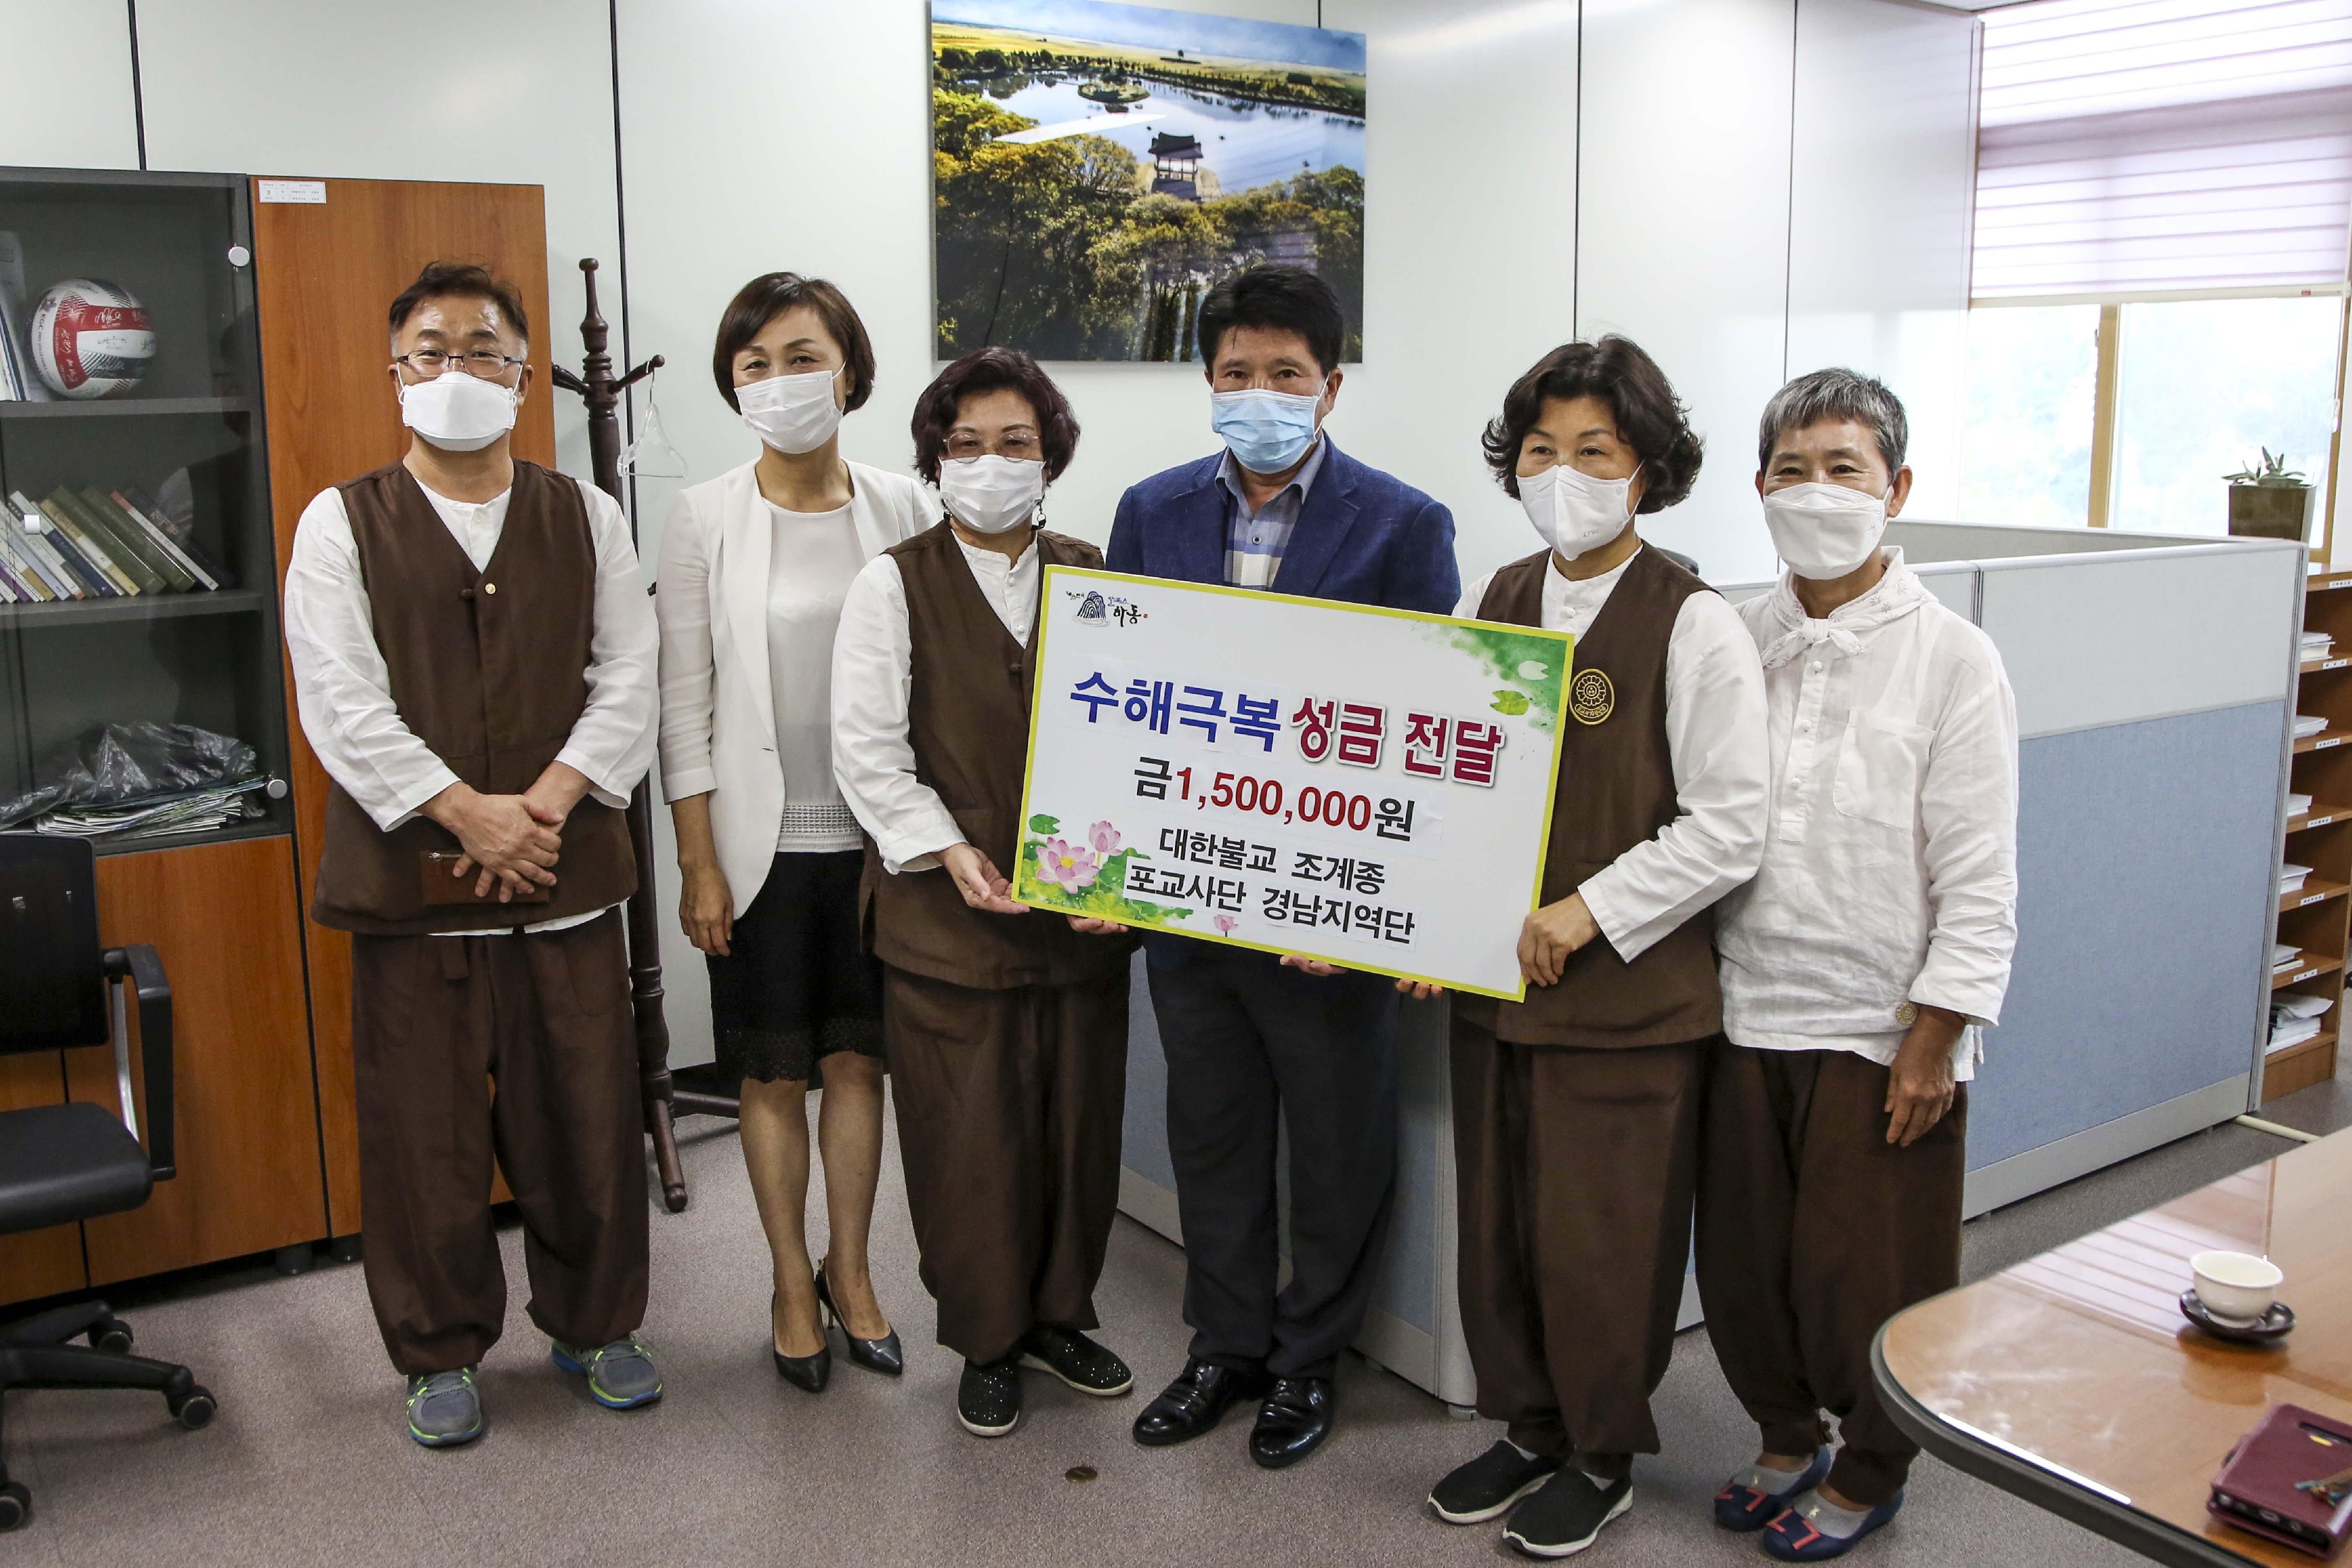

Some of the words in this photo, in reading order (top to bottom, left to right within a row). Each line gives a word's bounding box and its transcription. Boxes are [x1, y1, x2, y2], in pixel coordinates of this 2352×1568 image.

[1113, 604, 1142, 628] 하동
[1071, 672, 1281, 752] 수해극복
[1292, 697, 1384, 765] 성금
[1405, 713, 1505, 784] 전달
[1134, 757, 1415, 842] 금1,500,000원
[1159, 828, 1276, 873] 대한불교
[1292, 852, 1385, 895] 조계종
[1127, 864, 1246, 913] 포교사단
[1262, 887, 1415, 944] 경남지역단
